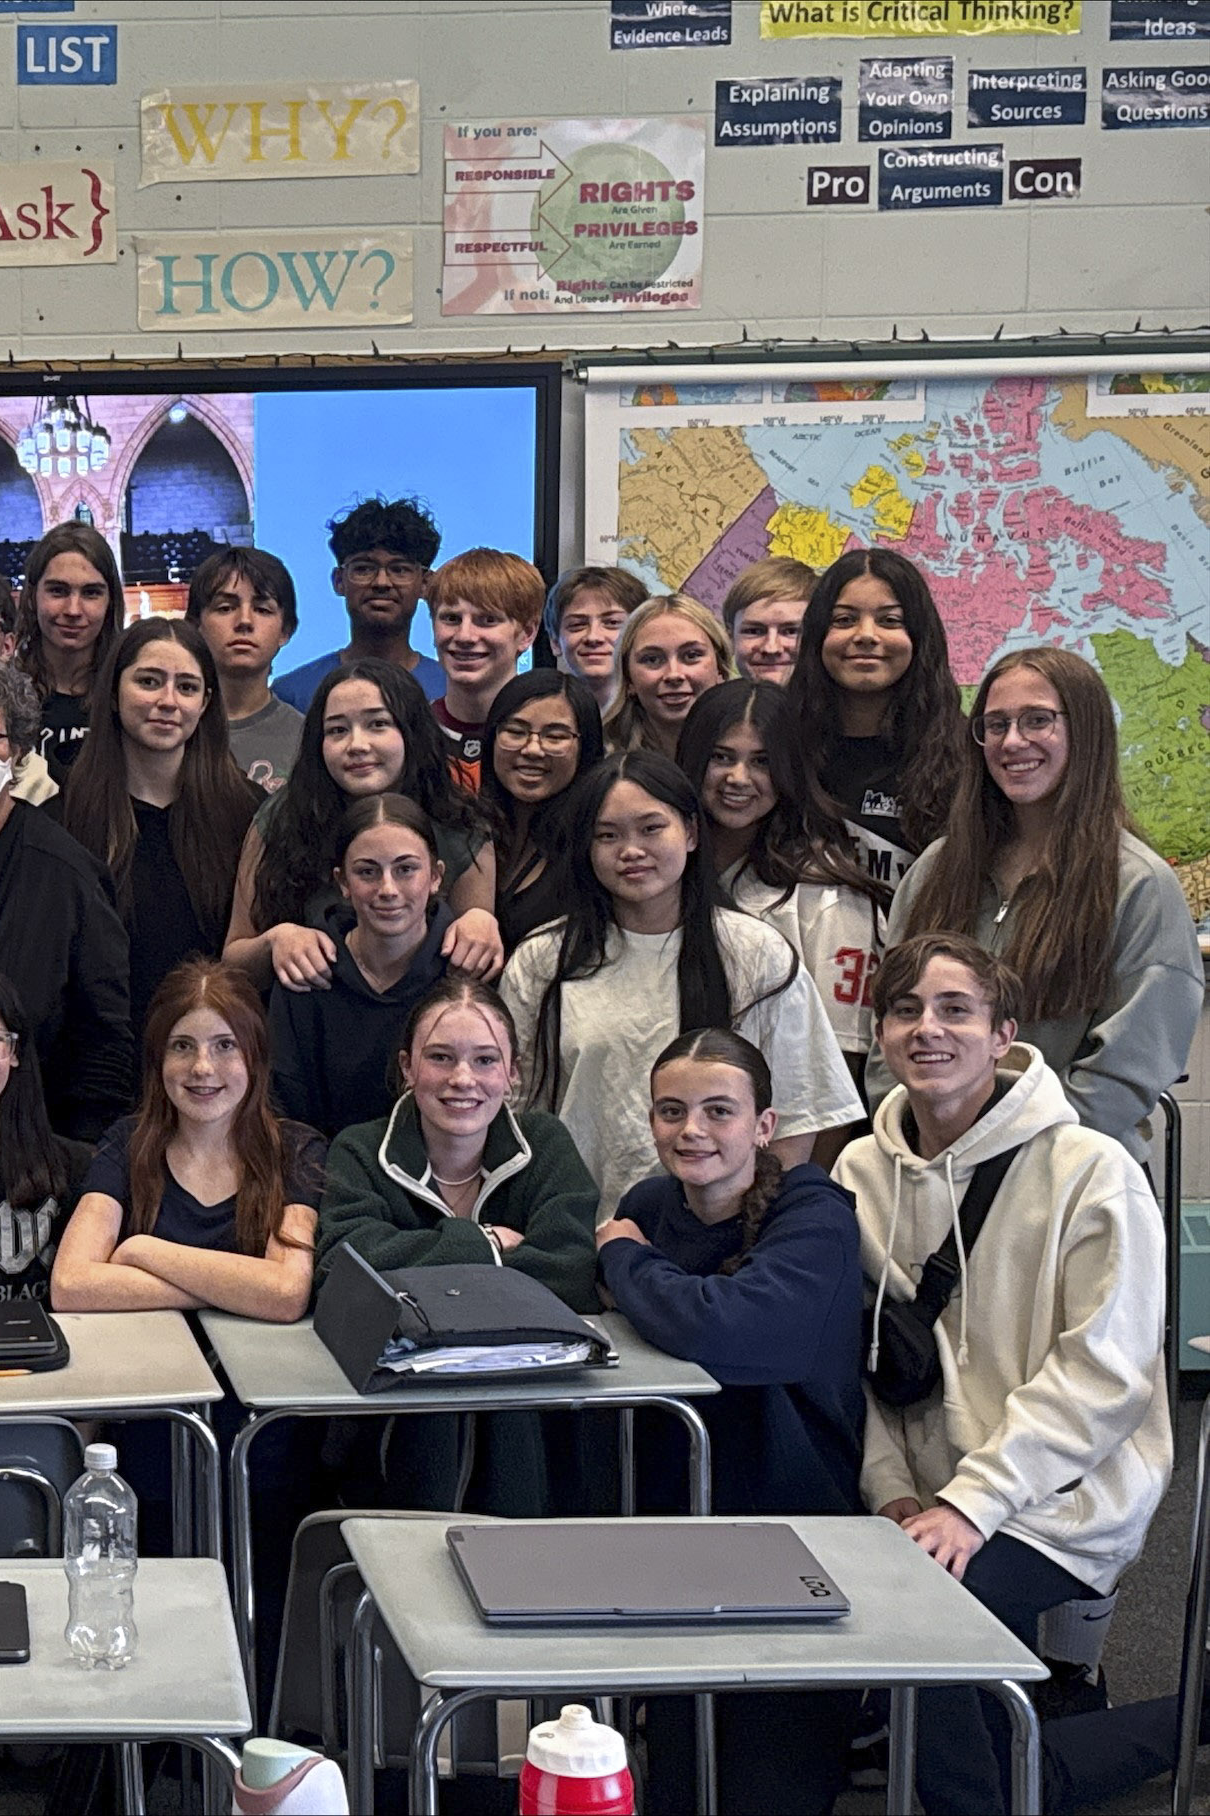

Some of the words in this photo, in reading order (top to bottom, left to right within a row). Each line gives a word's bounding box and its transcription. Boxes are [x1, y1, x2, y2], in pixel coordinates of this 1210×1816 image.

[646, 2, 697, 17] Where
[769, 0, 834, 24] What
[842, 2, 859, 22] is
[867, 0, 949, 22] Critical
[957, 0, 1074, 25] Thinking?
[614, 29, 681, 44] Evidence
[685, 26, 729, 42] Leads
[1144, 17, 1197, 36] Ideas
[25, 36, 110, 73] LIST
[869, 62, 946, 80] Adapting
[972, 70, 1083, 92] Interpreting
[1105, 70, 1167, 91] Asking
[1171, 70, 1210, 87] Goo
[729, 82, 831, 106] Explaining
[865, 92, 903, 107] Your
[908, 90, 948, 106] Own
[990, 103, 1062, 121] Sources
[1116, 103, 1209, 123] Questions
[157, 98, 408, 165] WHY?
[457, 126, 469, 138] If
[473, 128, 502, 141] you
[506, 125, 538, 137] are:
[719, 118, 838, 138] Assumptions
[868, 118, 944, 139] Opinions
[883, 148, 999, 169] Constructing
[455, 168, 556, 182] RESPONSIBLE
[811, 170, 865, 199] Pro
[1014, 165, 1075, 194] Con
[579, 180, 696, 204] RIGHTS
[890, 181, 991, 204] Arguments
[573, 220, 699, 238] PRIVILEGES
[455, 241, 549, 254] RESPECTFUL
[155, 249, 397, 316] HOW?
[504, 289, 515, 301] If
[520, 288, 550, 301] not:
[1098, 474, 1121, 489] Bay
